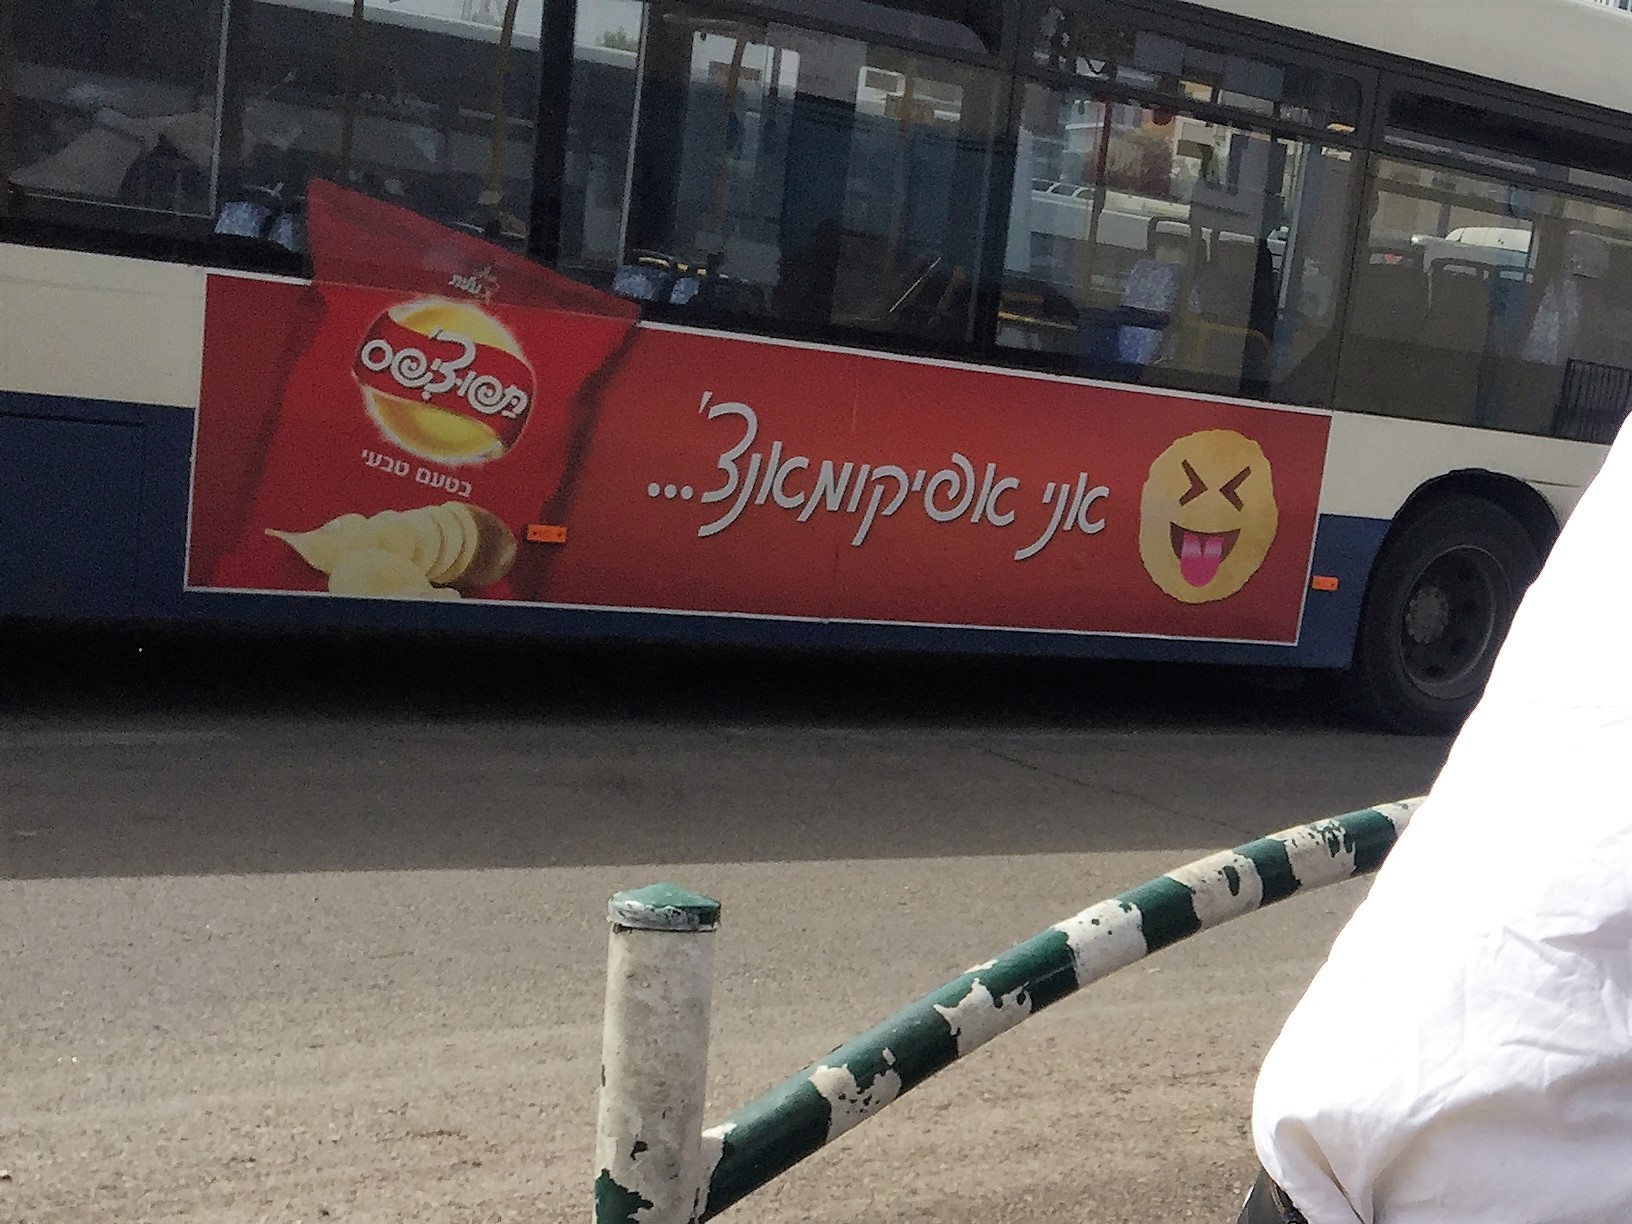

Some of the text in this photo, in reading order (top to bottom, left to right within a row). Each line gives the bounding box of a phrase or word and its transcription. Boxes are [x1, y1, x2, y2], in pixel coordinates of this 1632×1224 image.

[361, 449, 473, 497] בטעם טבעי
[1013, 472, 1110, 561] אני
